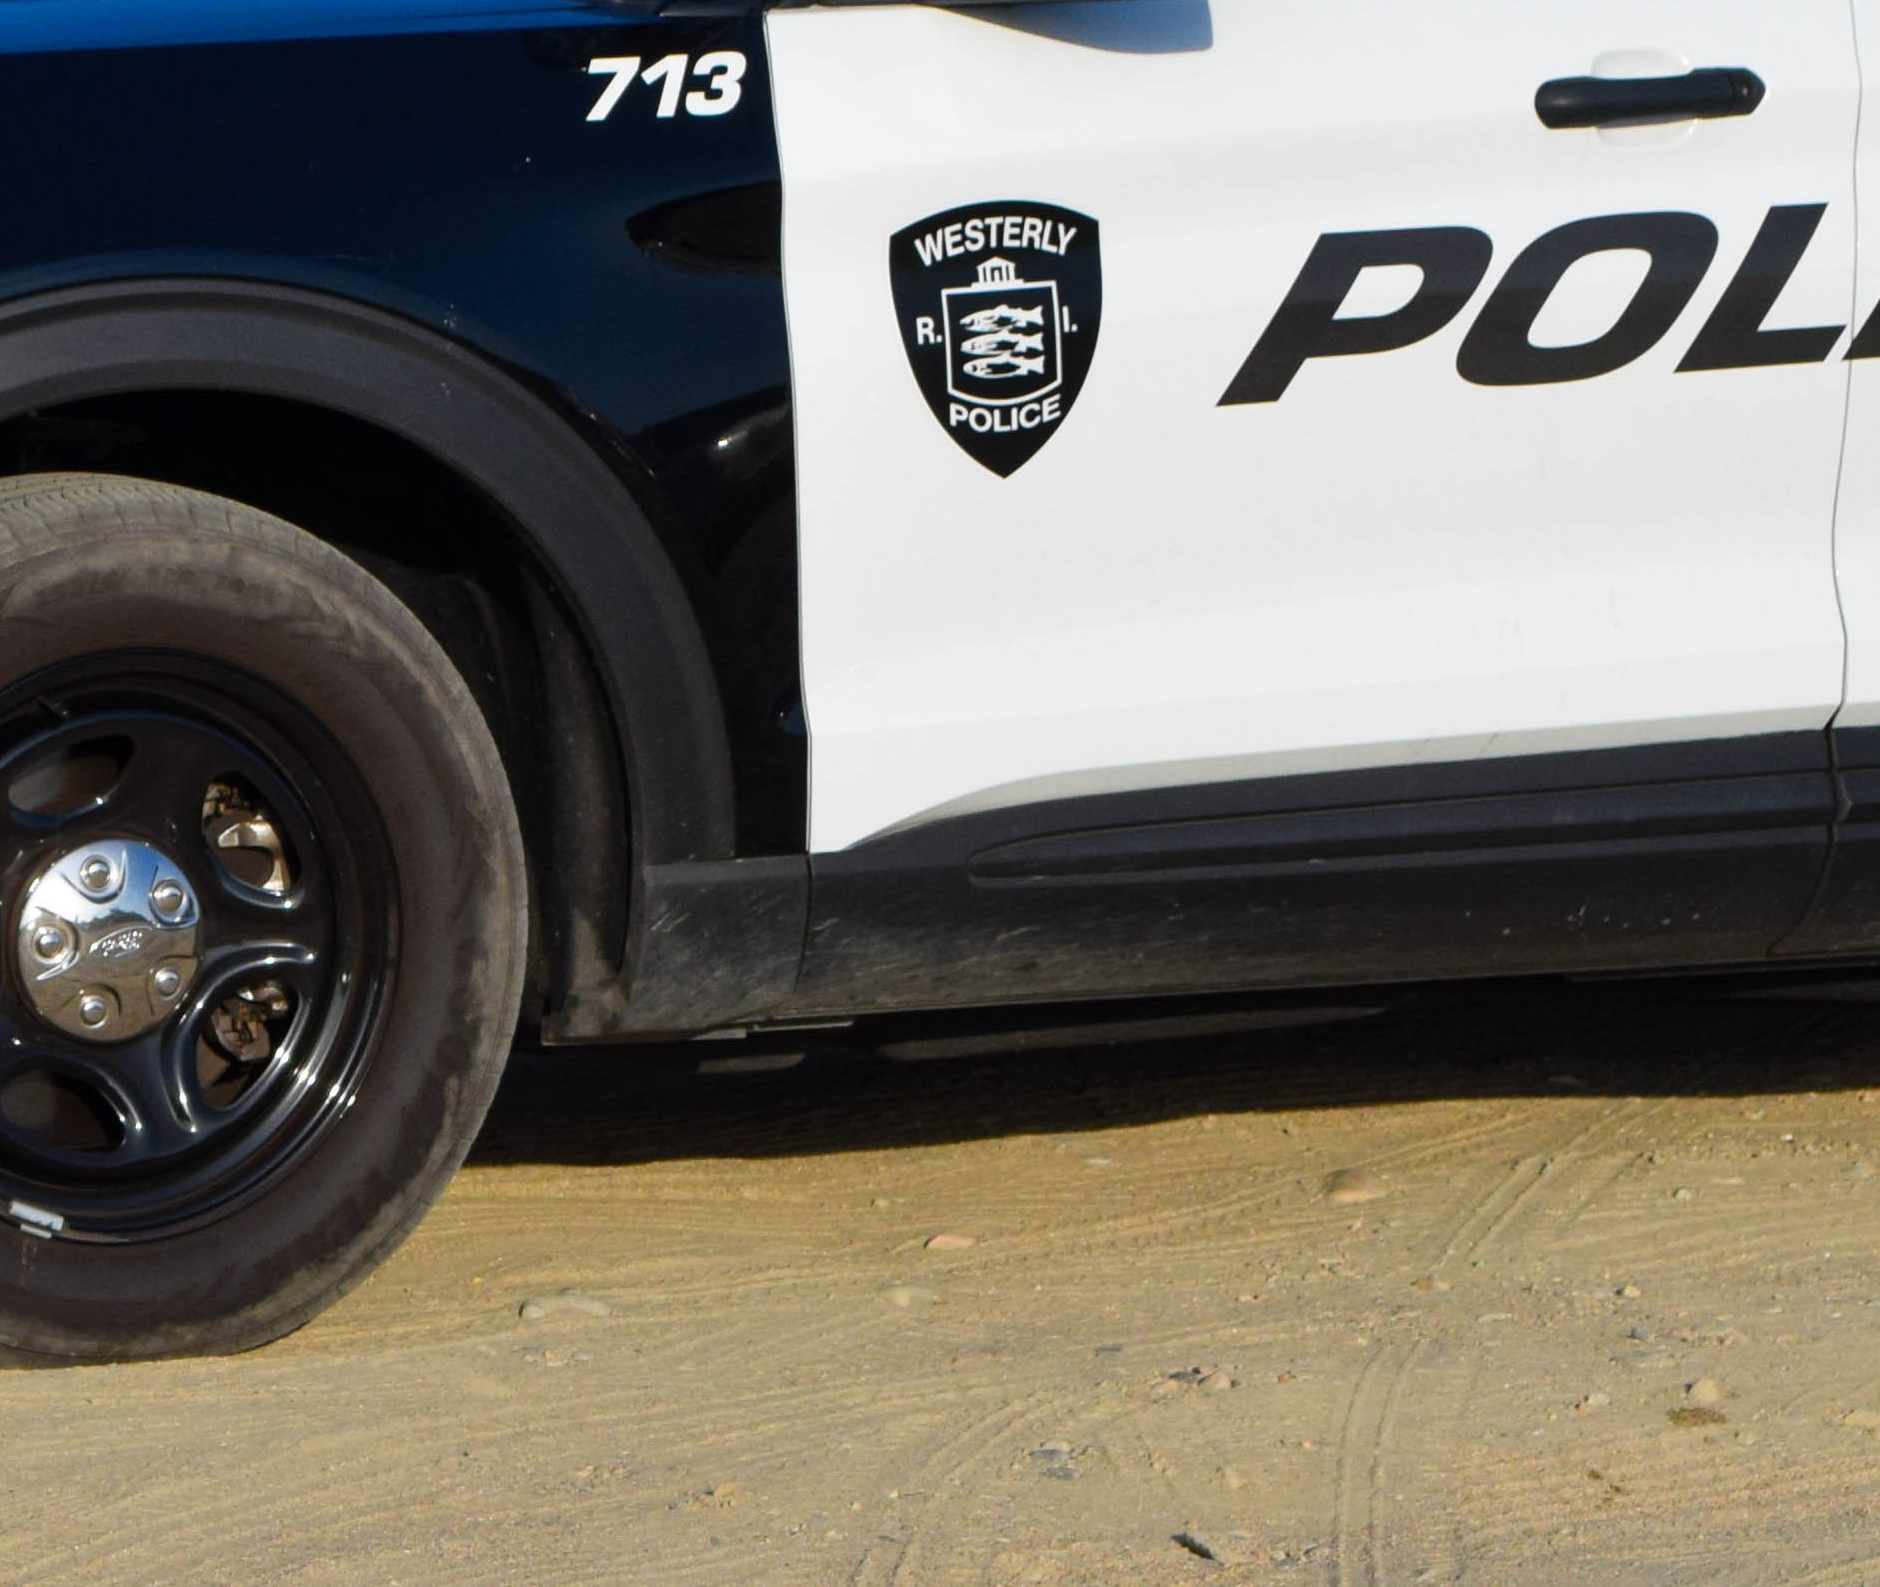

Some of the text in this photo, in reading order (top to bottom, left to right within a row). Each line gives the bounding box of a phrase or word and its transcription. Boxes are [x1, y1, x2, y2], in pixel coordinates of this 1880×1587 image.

[585, 50, 747, 122] 713
[914, 215, 1078, 267] WESTERLY
[915, 316, 944, 346] R.
[948, 393, 1062, 434] POLICE
